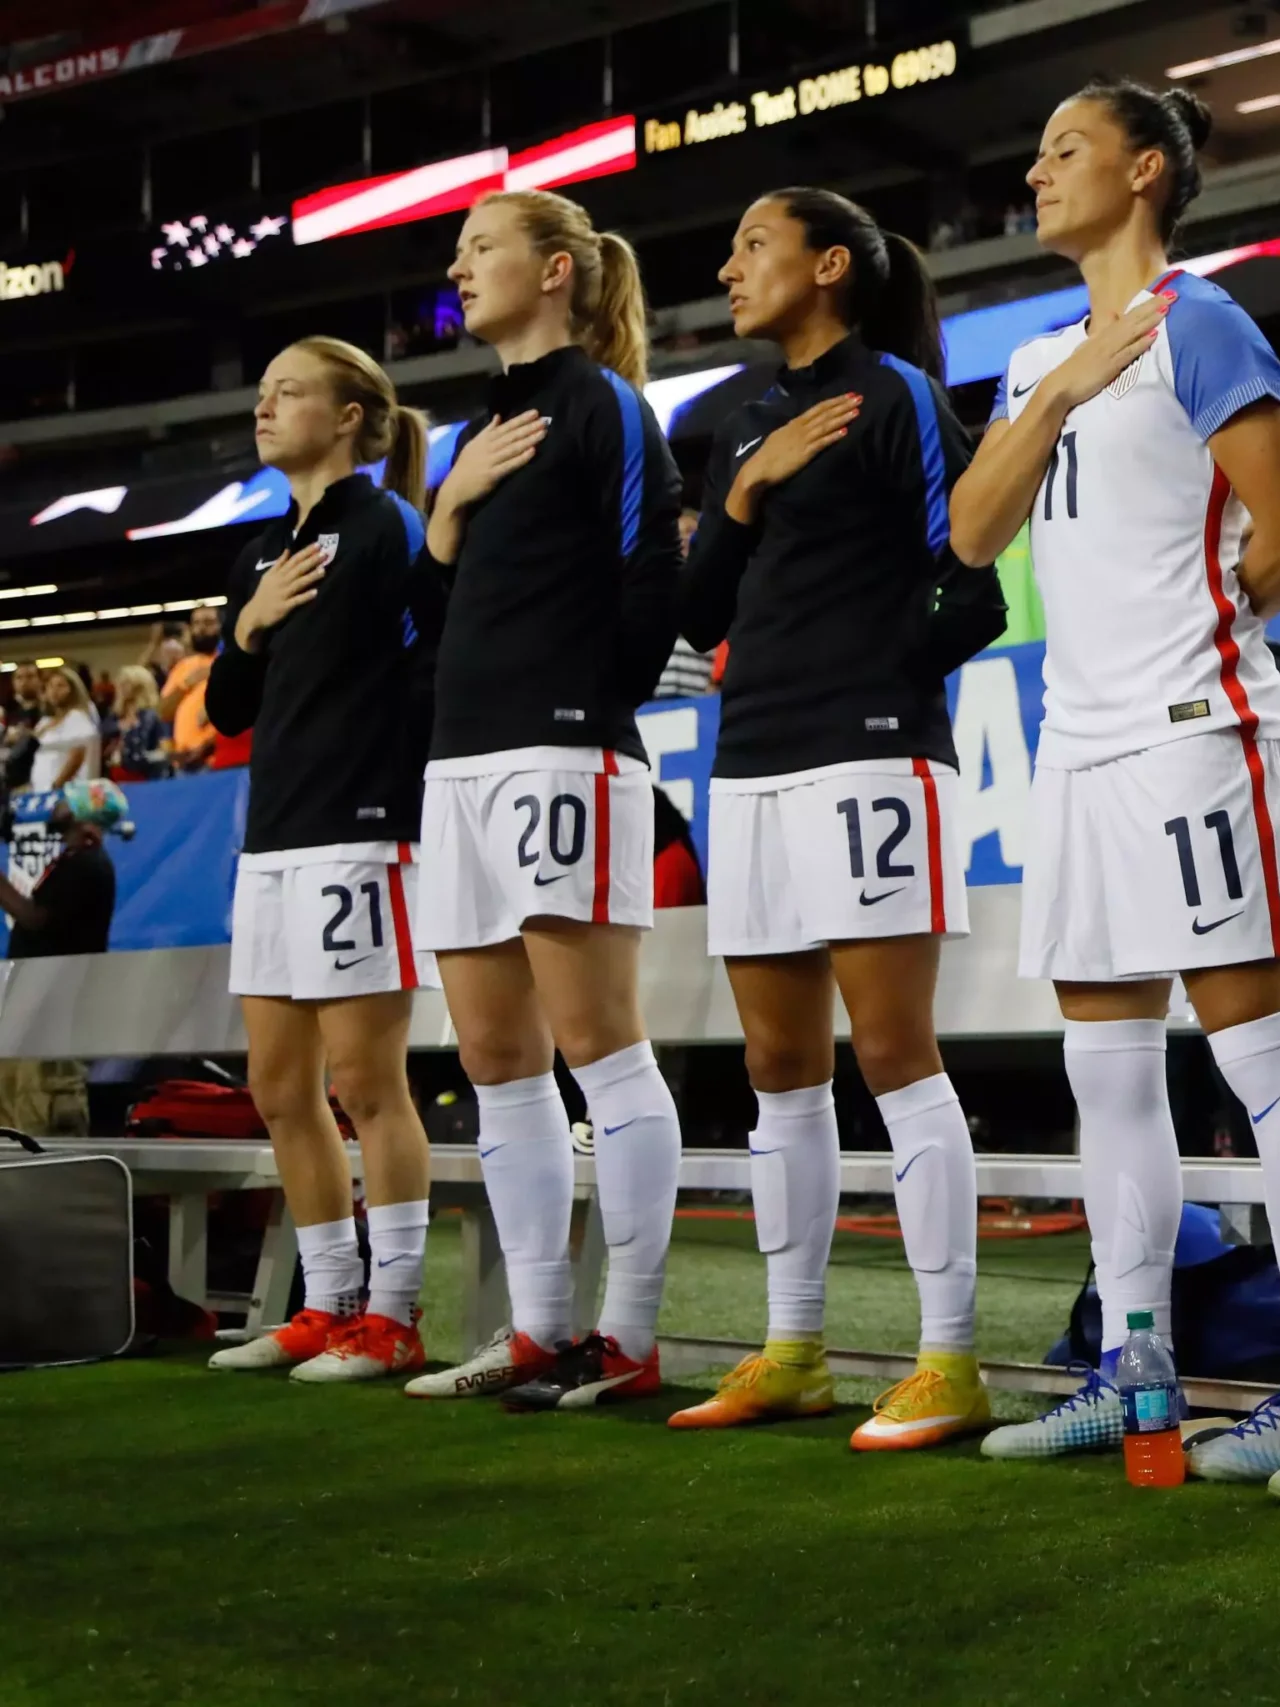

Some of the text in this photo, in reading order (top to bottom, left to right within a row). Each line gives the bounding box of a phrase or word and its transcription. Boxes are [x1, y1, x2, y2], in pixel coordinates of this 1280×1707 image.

[644, 118, 681, 153] Fan
[751, 86, 796, 127] Text
[798, 65, 861, 116] DOME
[863, 63, 889, 97] to
[513, 793, 587, 868] 20
[836, 796, 915, 879] 12
[1164, 808, 1244, 907] 11
[321, 880, 384, 952] 21
